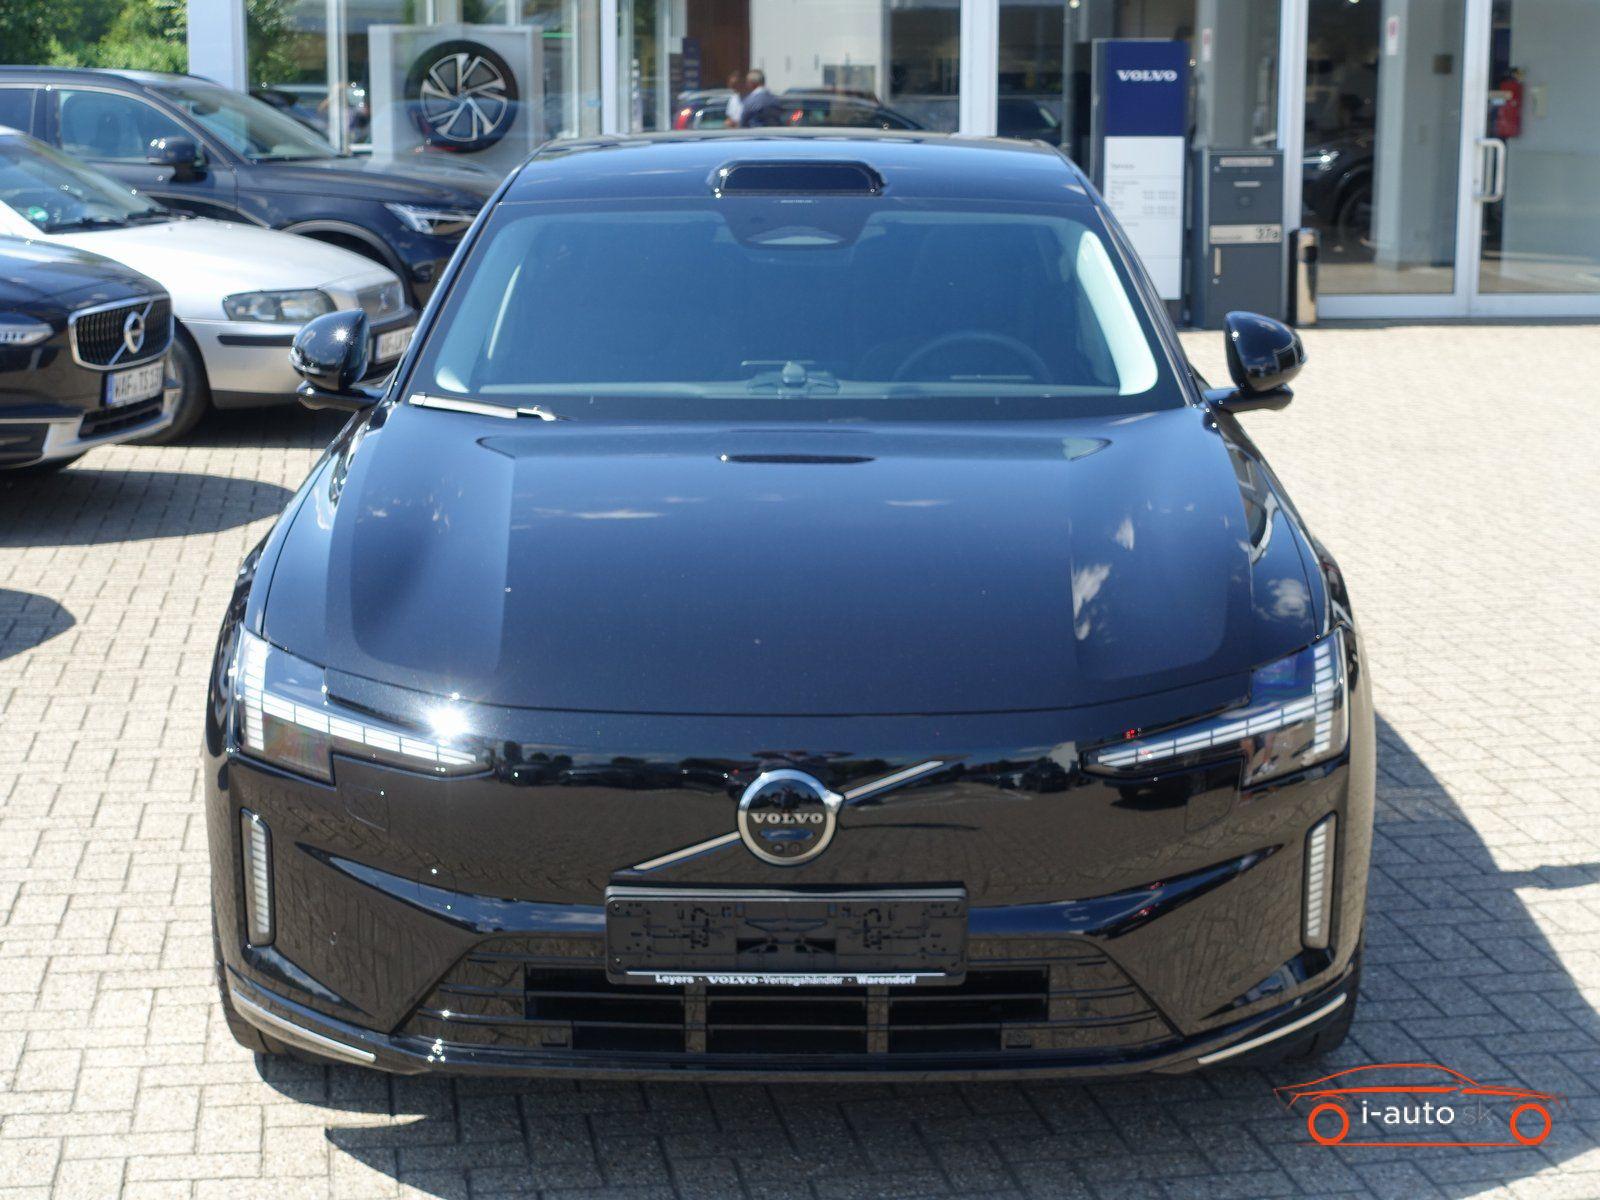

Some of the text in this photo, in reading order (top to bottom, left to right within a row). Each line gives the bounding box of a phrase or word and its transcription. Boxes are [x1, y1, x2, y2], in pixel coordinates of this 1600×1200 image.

[1117, 69, 1178, 82] VOLVO
[750, 812, 824, 825] VOLVO
[856, 974, 917, 985] Warendorf
